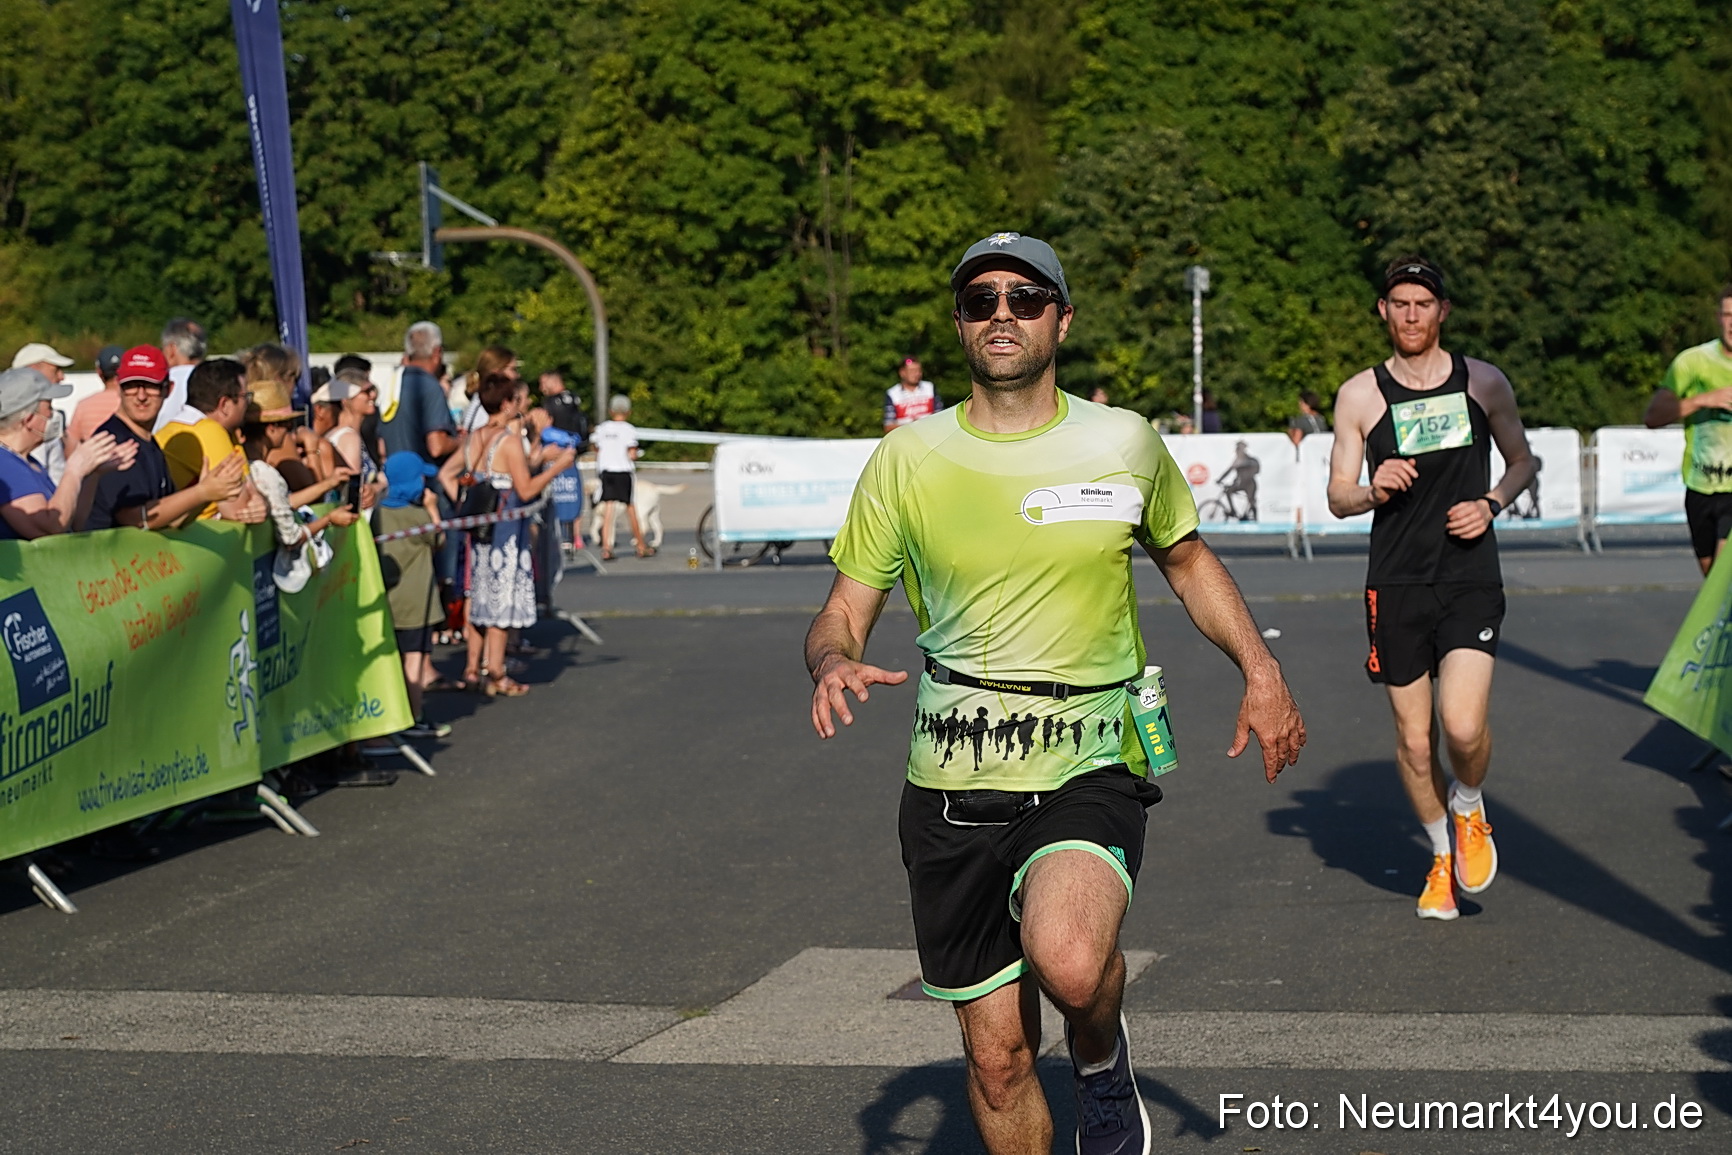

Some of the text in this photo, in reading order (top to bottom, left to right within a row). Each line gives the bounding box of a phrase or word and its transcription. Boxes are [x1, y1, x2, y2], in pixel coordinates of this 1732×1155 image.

[1414, 414, 1451, 435] 152
[1081, 488, 1113, 496] Klinikum
[12, 623, 49, 654] Fischer
[980, 680, 1021, 691] NATHAN
[0, 660, 114, 779] firmenlauf
[1145, 722, 1165, 756] RUN
